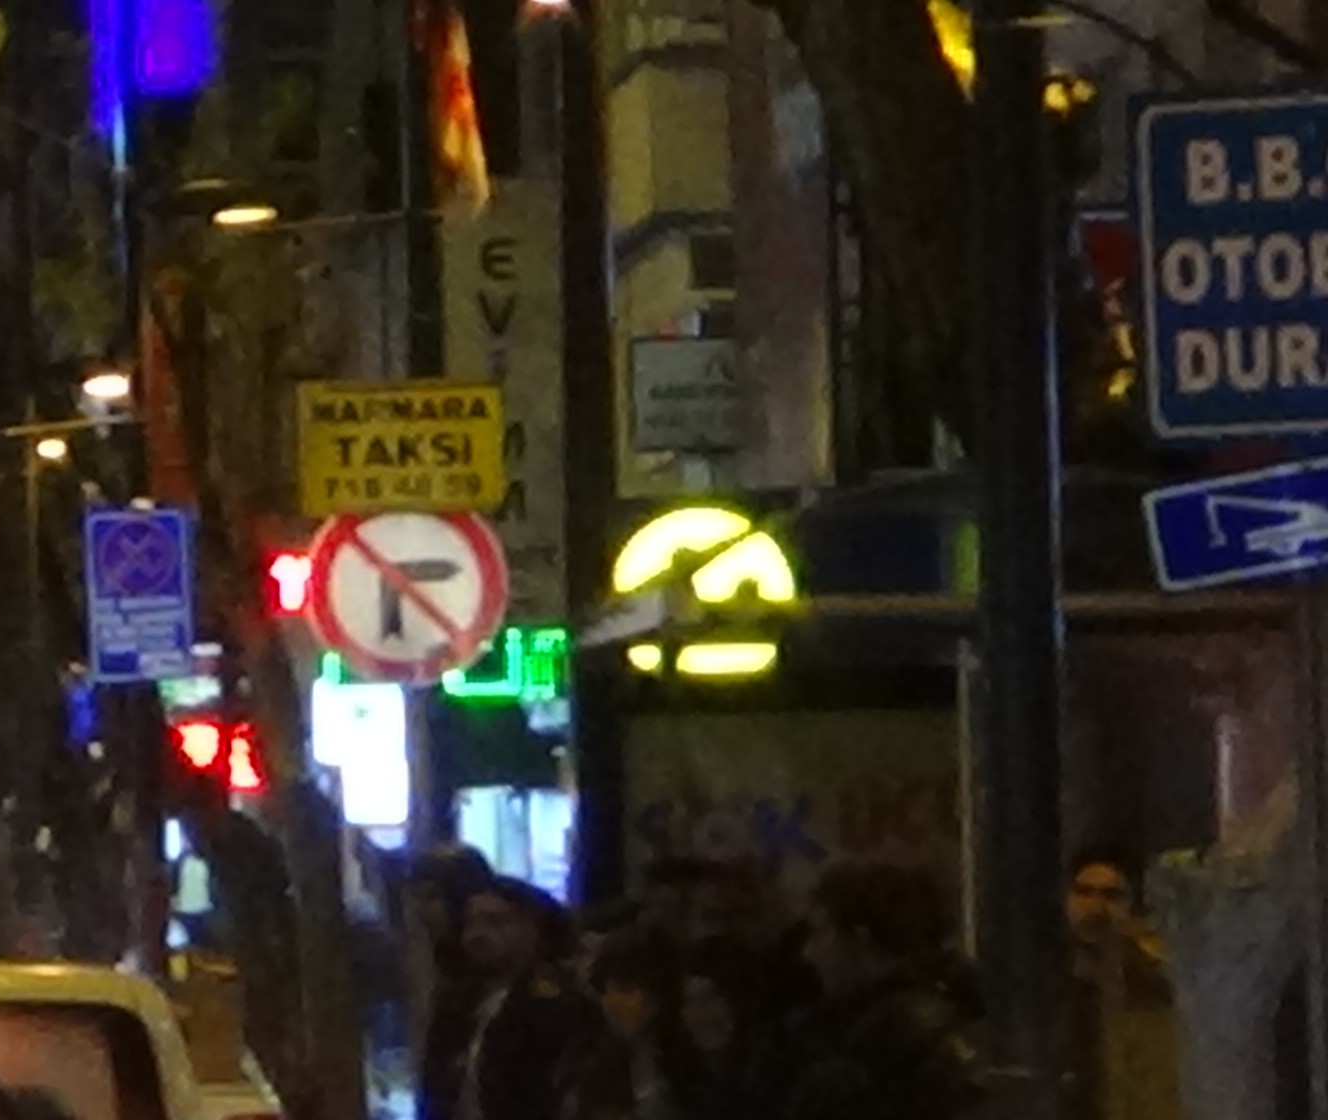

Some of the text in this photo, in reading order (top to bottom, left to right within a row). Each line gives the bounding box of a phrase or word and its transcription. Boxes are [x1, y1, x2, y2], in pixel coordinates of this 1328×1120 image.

[1175, 320, 1328, 393] DUR
[310, 396, 490, 424] MARMARA
[334, 432, 473, 468] TAKSI
